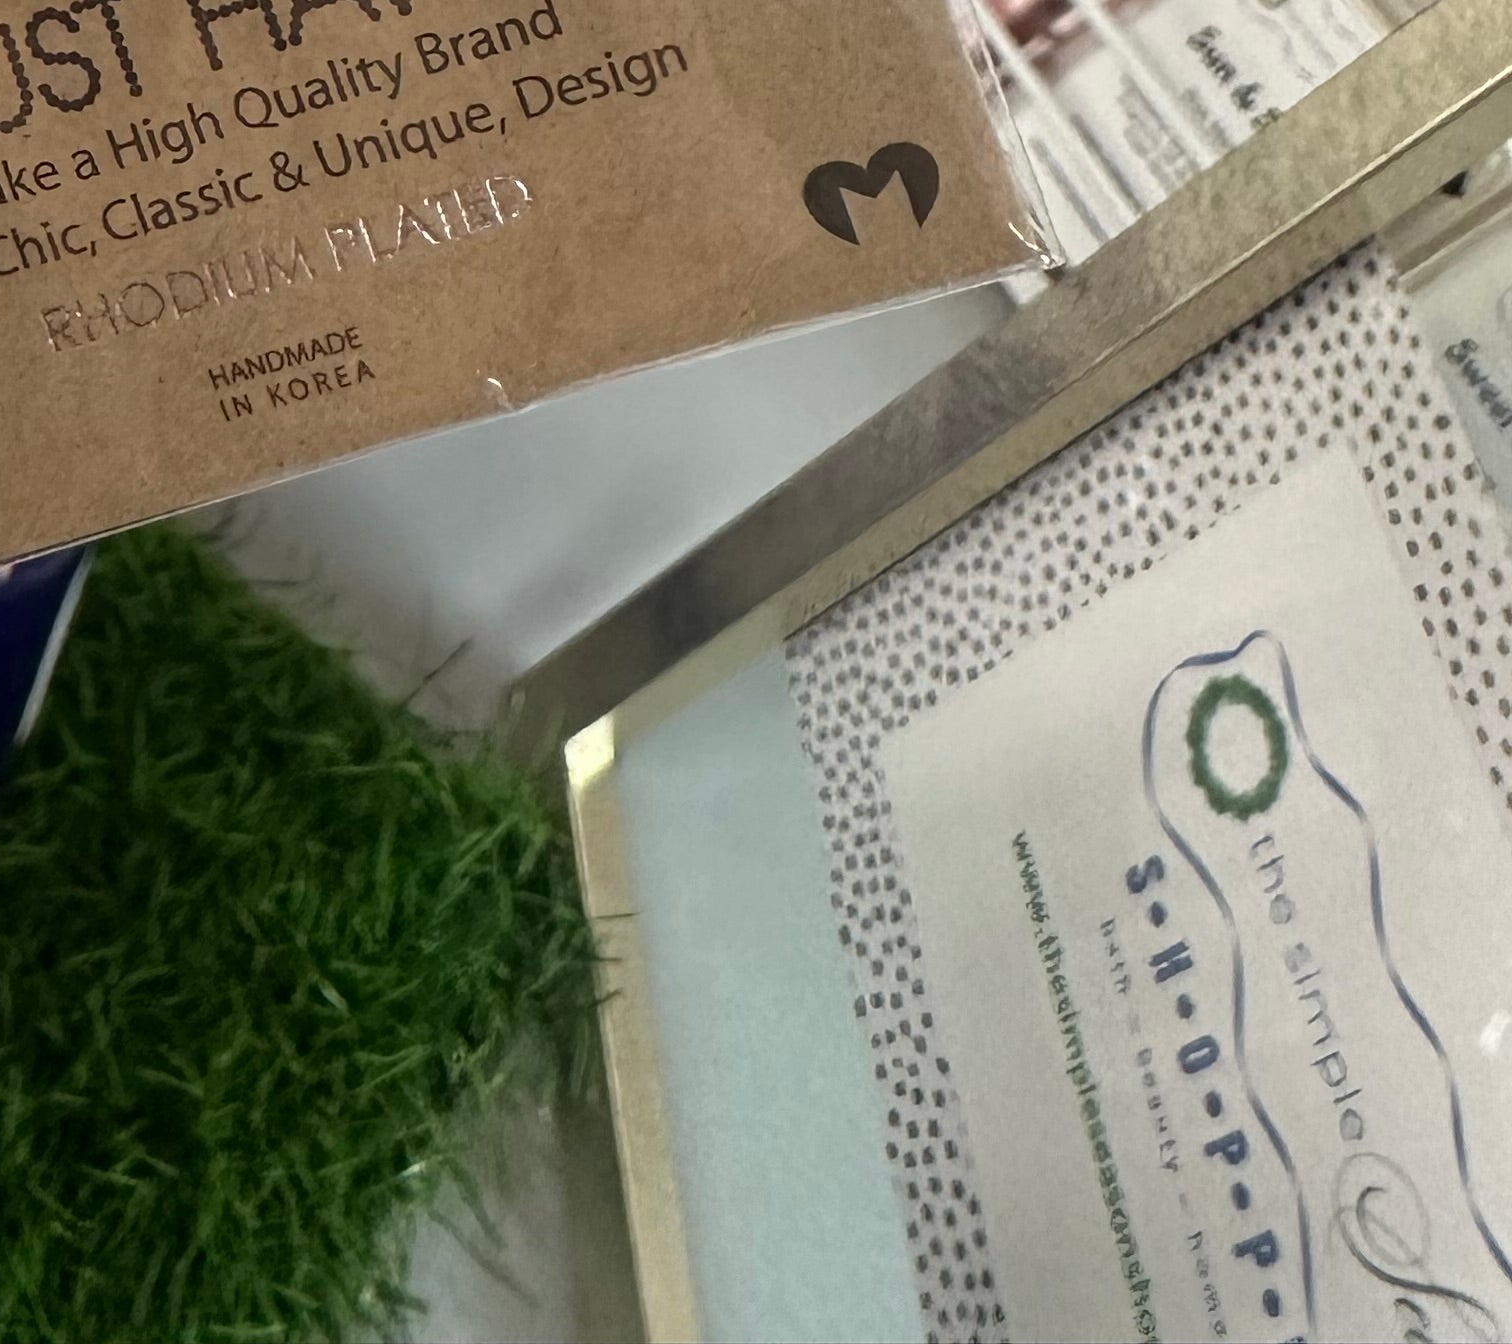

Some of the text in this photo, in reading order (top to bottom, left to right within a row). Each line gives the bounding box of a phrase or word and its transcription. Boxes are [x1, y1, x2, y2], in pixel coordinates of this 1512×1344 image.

[71, 148, 101, 181] a
[105, 102, 225, 169] High
[232, 51, 403, 129] Quality
[101, 167, 264, 241] Classic
[269, 150, 311, 192] &
[312, 99, 508, 178] Unique,
[511, 42, 689, 120] Design
[41, 174, 535, 353] RHODIUM PLATED
[208, 325, 378, 422] HANDMADE IN KOREA
[1283, 940, 1365, 1142] simple
